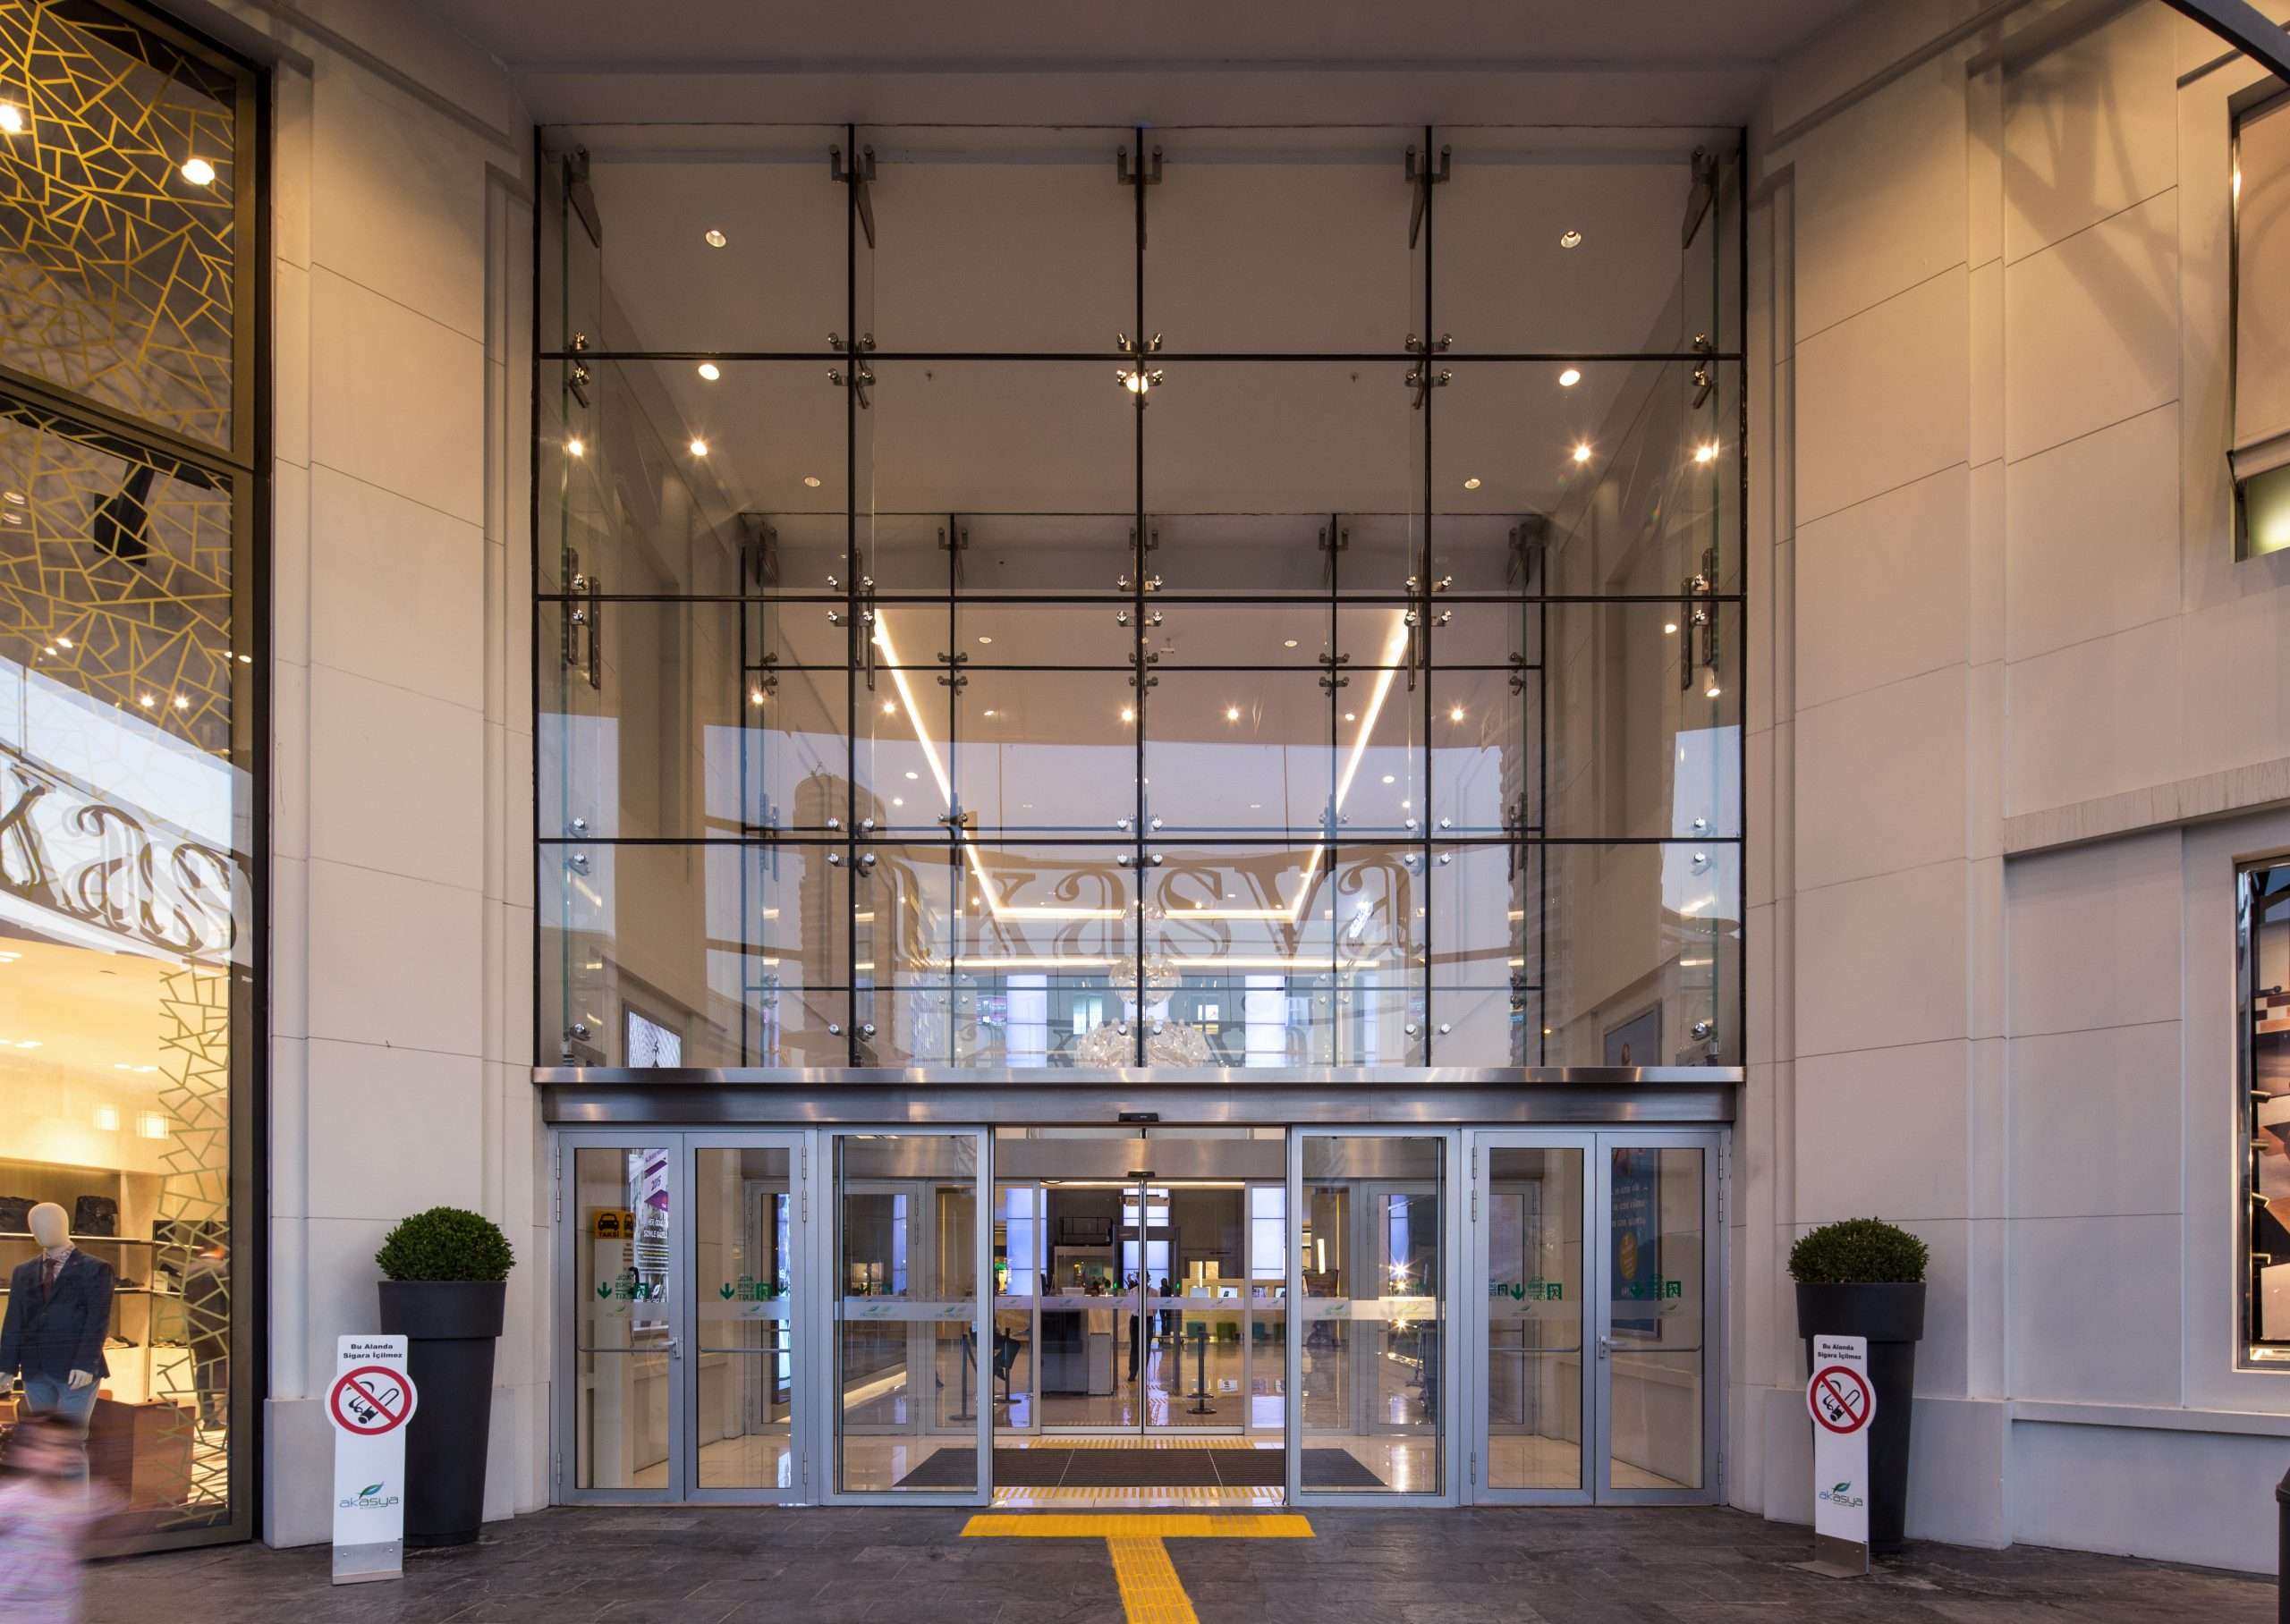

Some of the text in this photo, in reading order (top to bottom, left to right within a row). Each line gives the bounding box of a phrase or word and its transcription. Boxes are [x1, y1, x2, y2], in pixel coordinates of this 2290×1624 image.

[1818, 1351, 1837, 1359] Sigara
[339, 1496, 399, 1508] akasya
[1818, 1490, 1863, 1508] akasya
